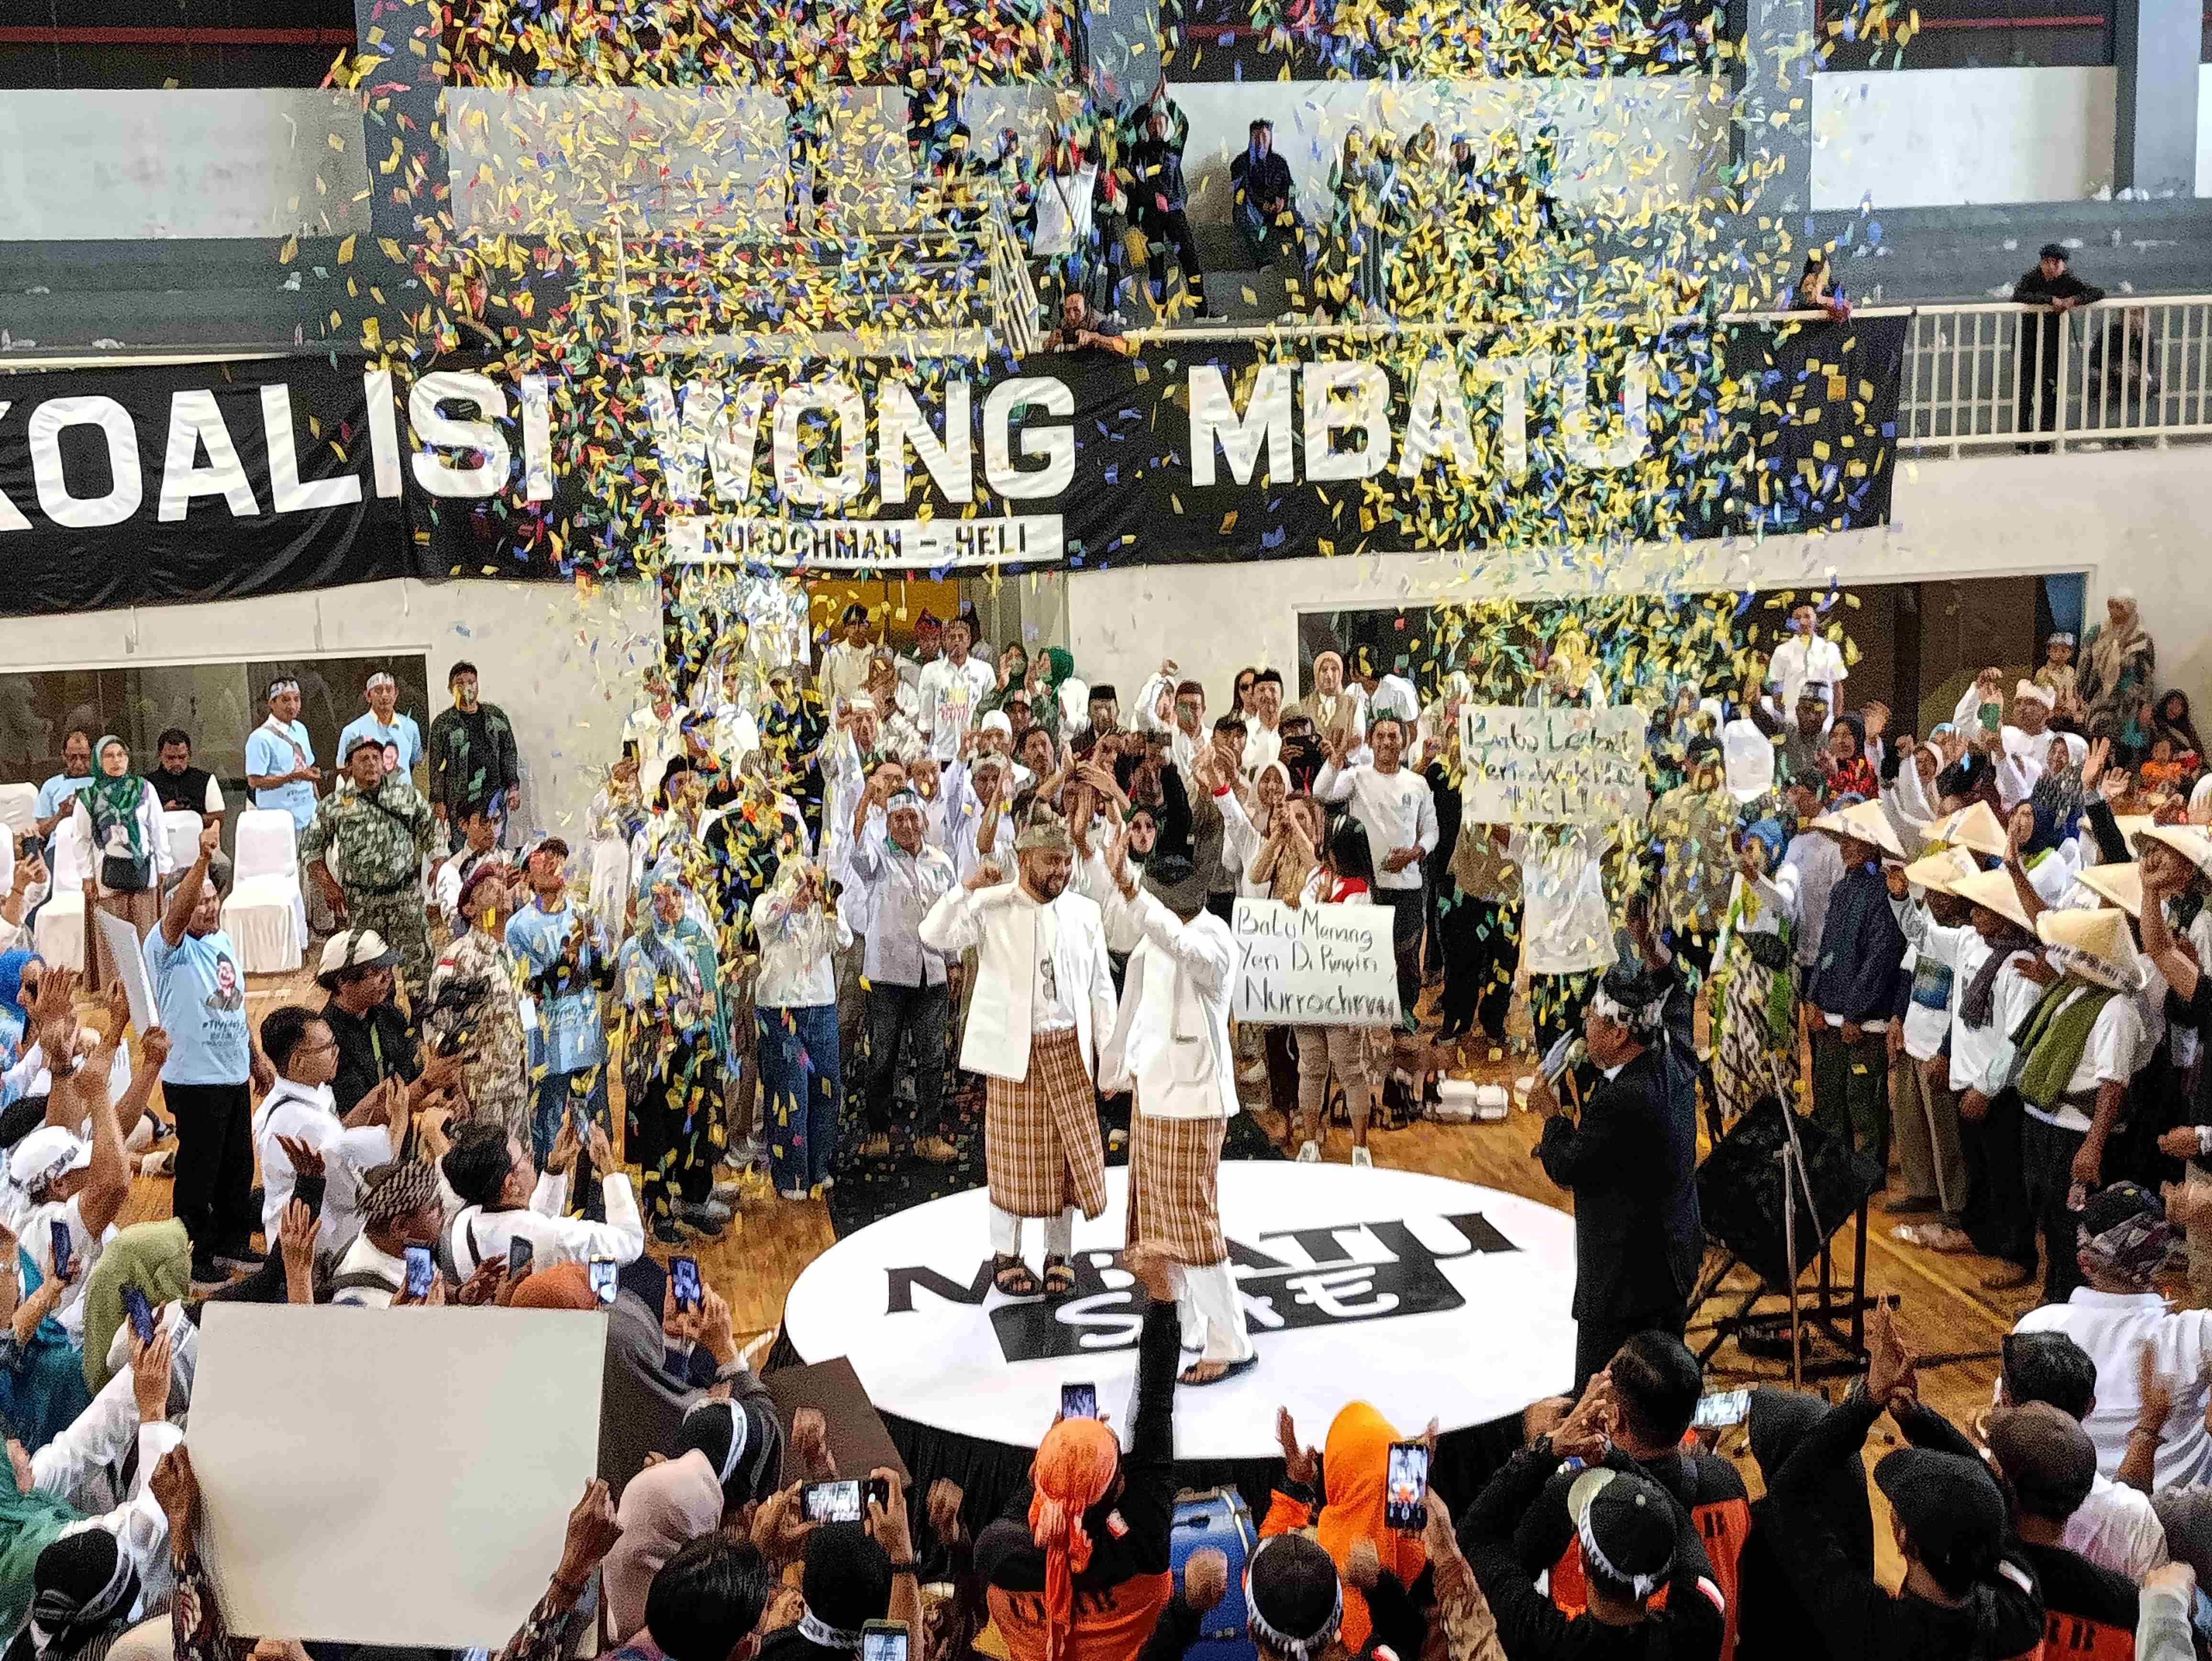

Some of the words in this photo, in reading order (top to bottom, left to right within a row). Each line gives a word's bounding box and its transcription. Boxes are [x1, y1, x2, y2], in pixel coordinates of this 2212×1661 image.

[643, 376, 1075, 506] WONG
[1188, 353, 1648, 487] MBATU
[955, 521, 1027, 557] HELI
